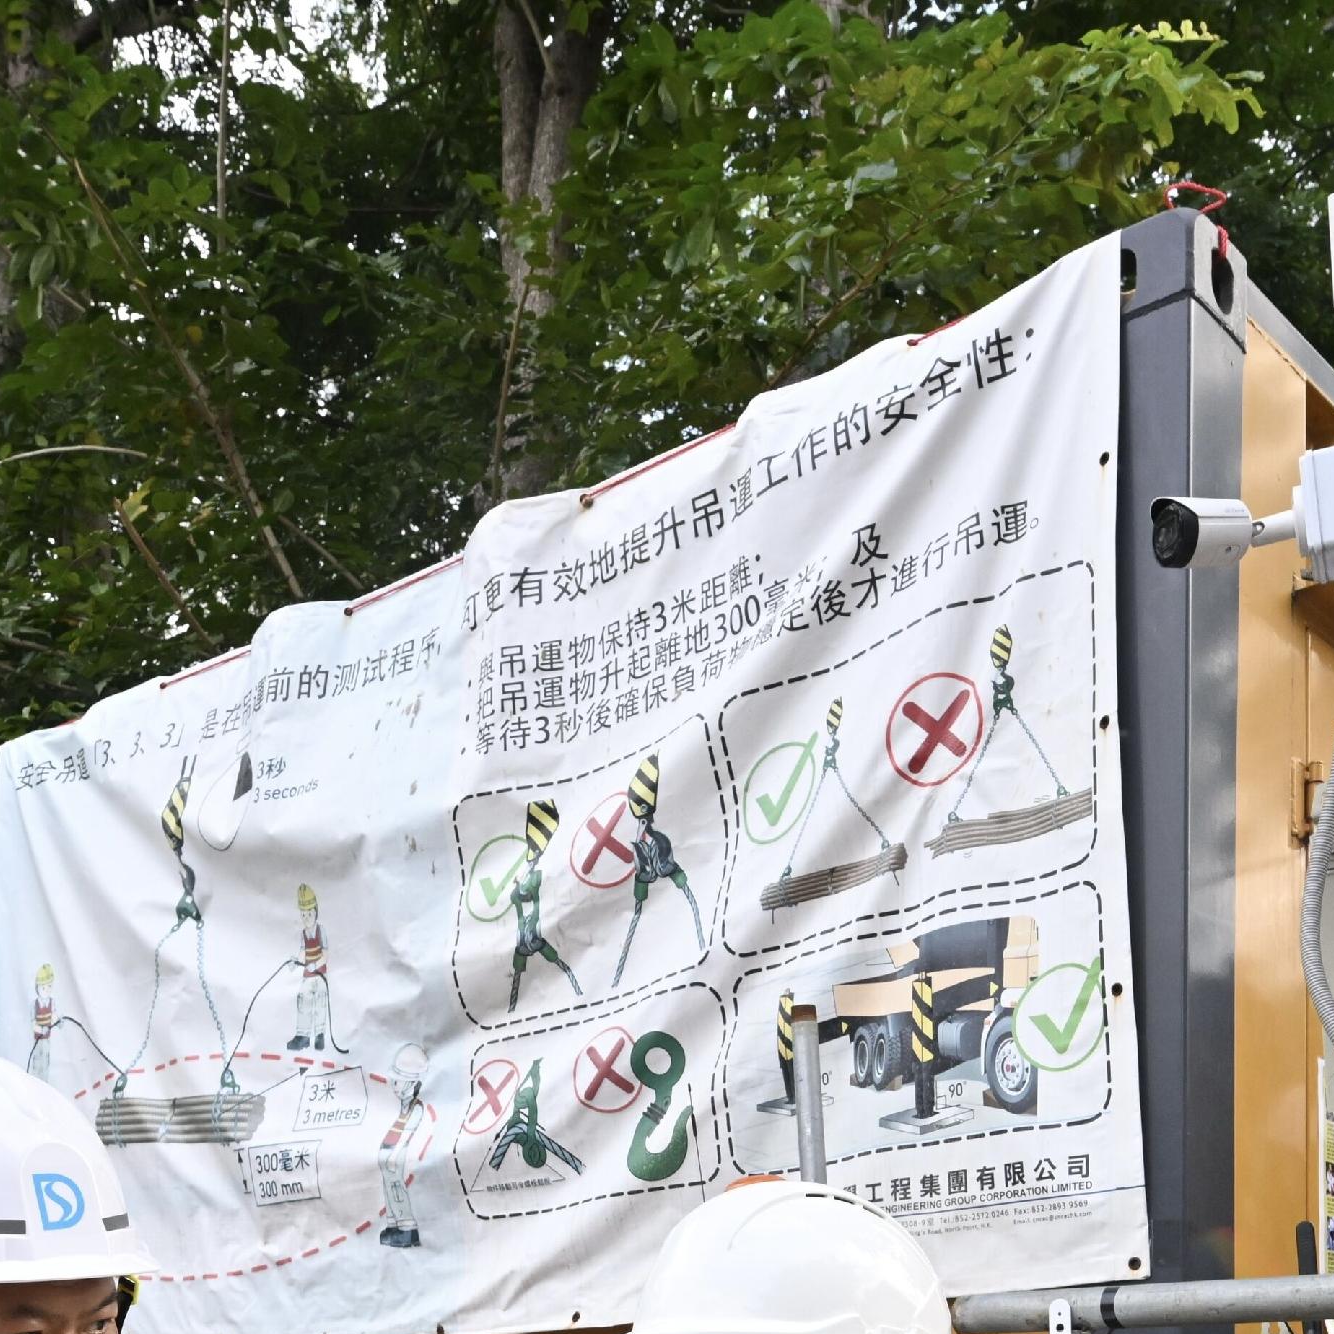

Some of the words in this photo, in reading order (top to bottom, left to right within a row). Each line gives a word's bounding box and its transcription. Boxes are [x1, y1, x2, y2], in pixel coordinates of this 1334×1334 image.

[256, 756, 287, 780] 3秒
[263, 777, 319, 801] seconds
[308, 1079, 336, 1102] 3米
[302, 1109, 311, 1125] 3
[313, 1106, 361, 1122] metres
[255, 1149, 310, 1173] 300毫米
[259, 1181, 279, 1198] 300
[280, 1181, 304, 1196] mm
[944, 1194, 978, 1208] GROUP
[979, 1184, 1049, 1203] CORPORATION
[1051, 1180, 1094, 1194] LIMITED
